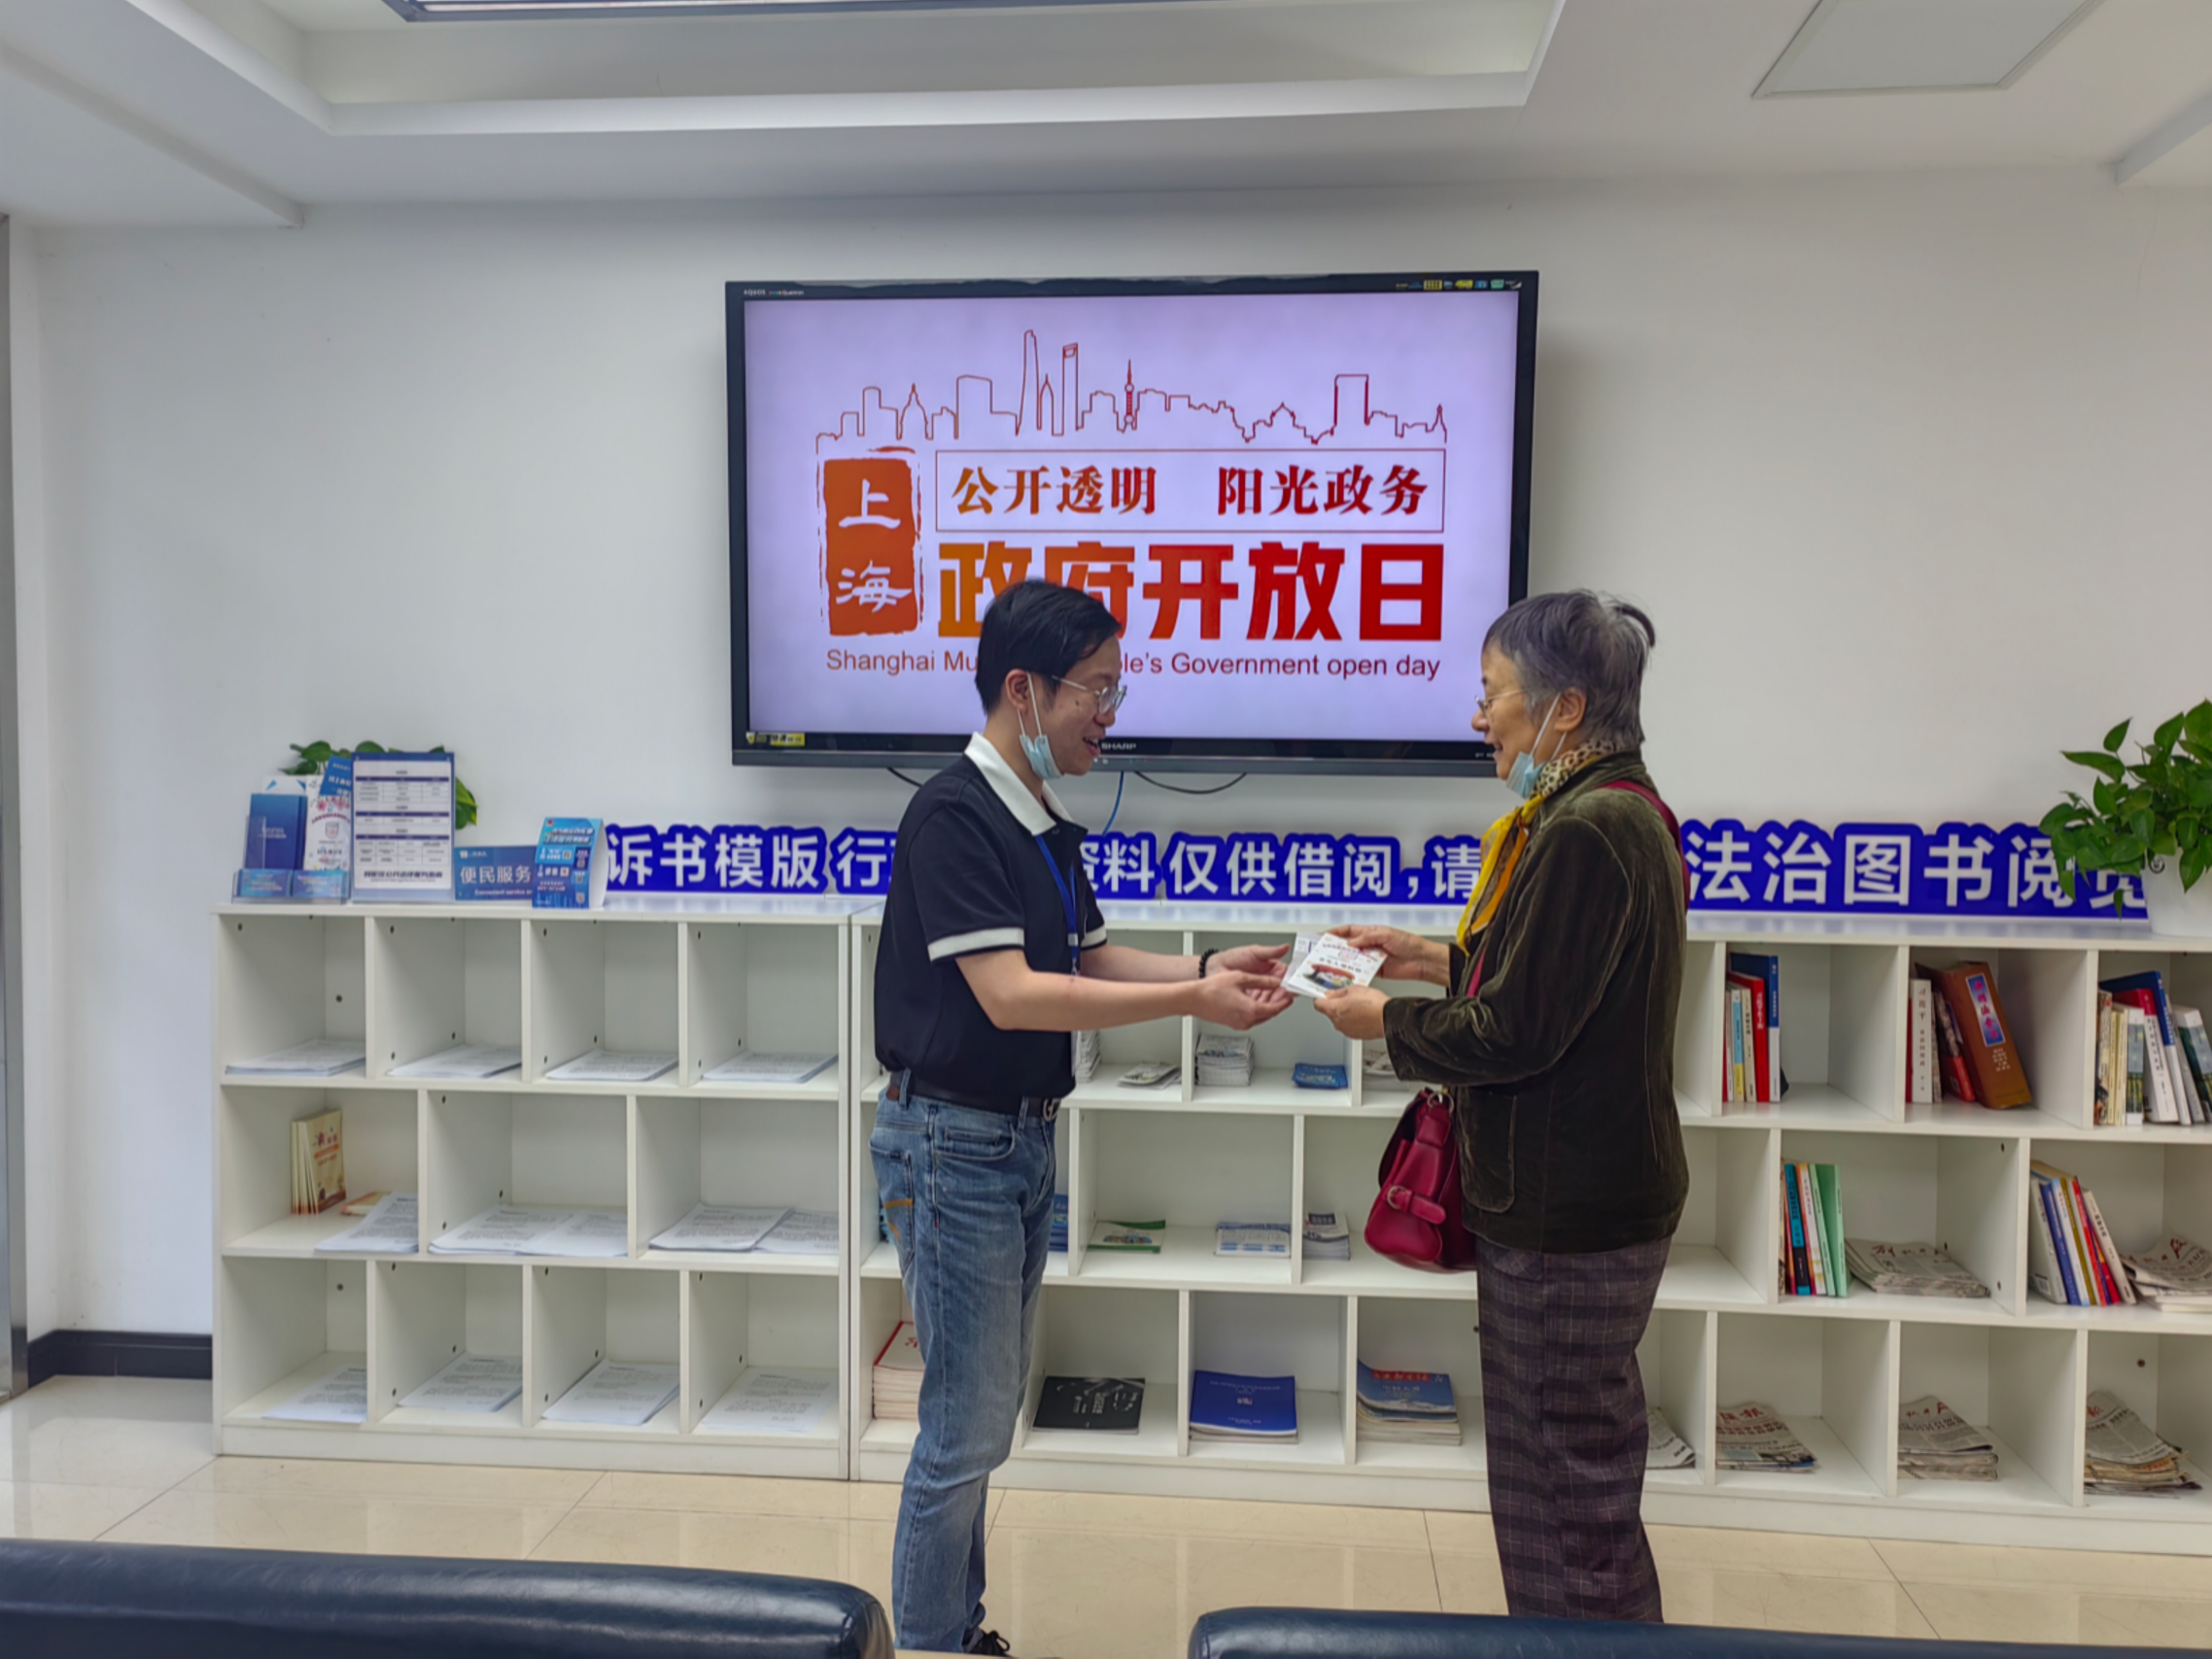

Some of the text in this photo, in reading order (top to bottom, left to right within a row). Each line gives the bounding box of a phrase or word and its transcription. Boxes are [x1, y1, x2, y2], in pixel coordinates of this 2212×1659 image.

[951, 465, 1428, 516] 公开透明 阳光政务
[836, 478, 913, 613] 上海
[938, 540, 1444, 641] 政府开放日
[827, 648, 935, 676] Shanghai
[1120, 652, 1162, 674] le's
[1171, 652, 1319, 674] Government
[1327, 658, 1388, 680] open
[1396, 654, 1440, 681] day
[461, 865, 532, 884] 便民服务
[837, 834, 895, 887] 行
